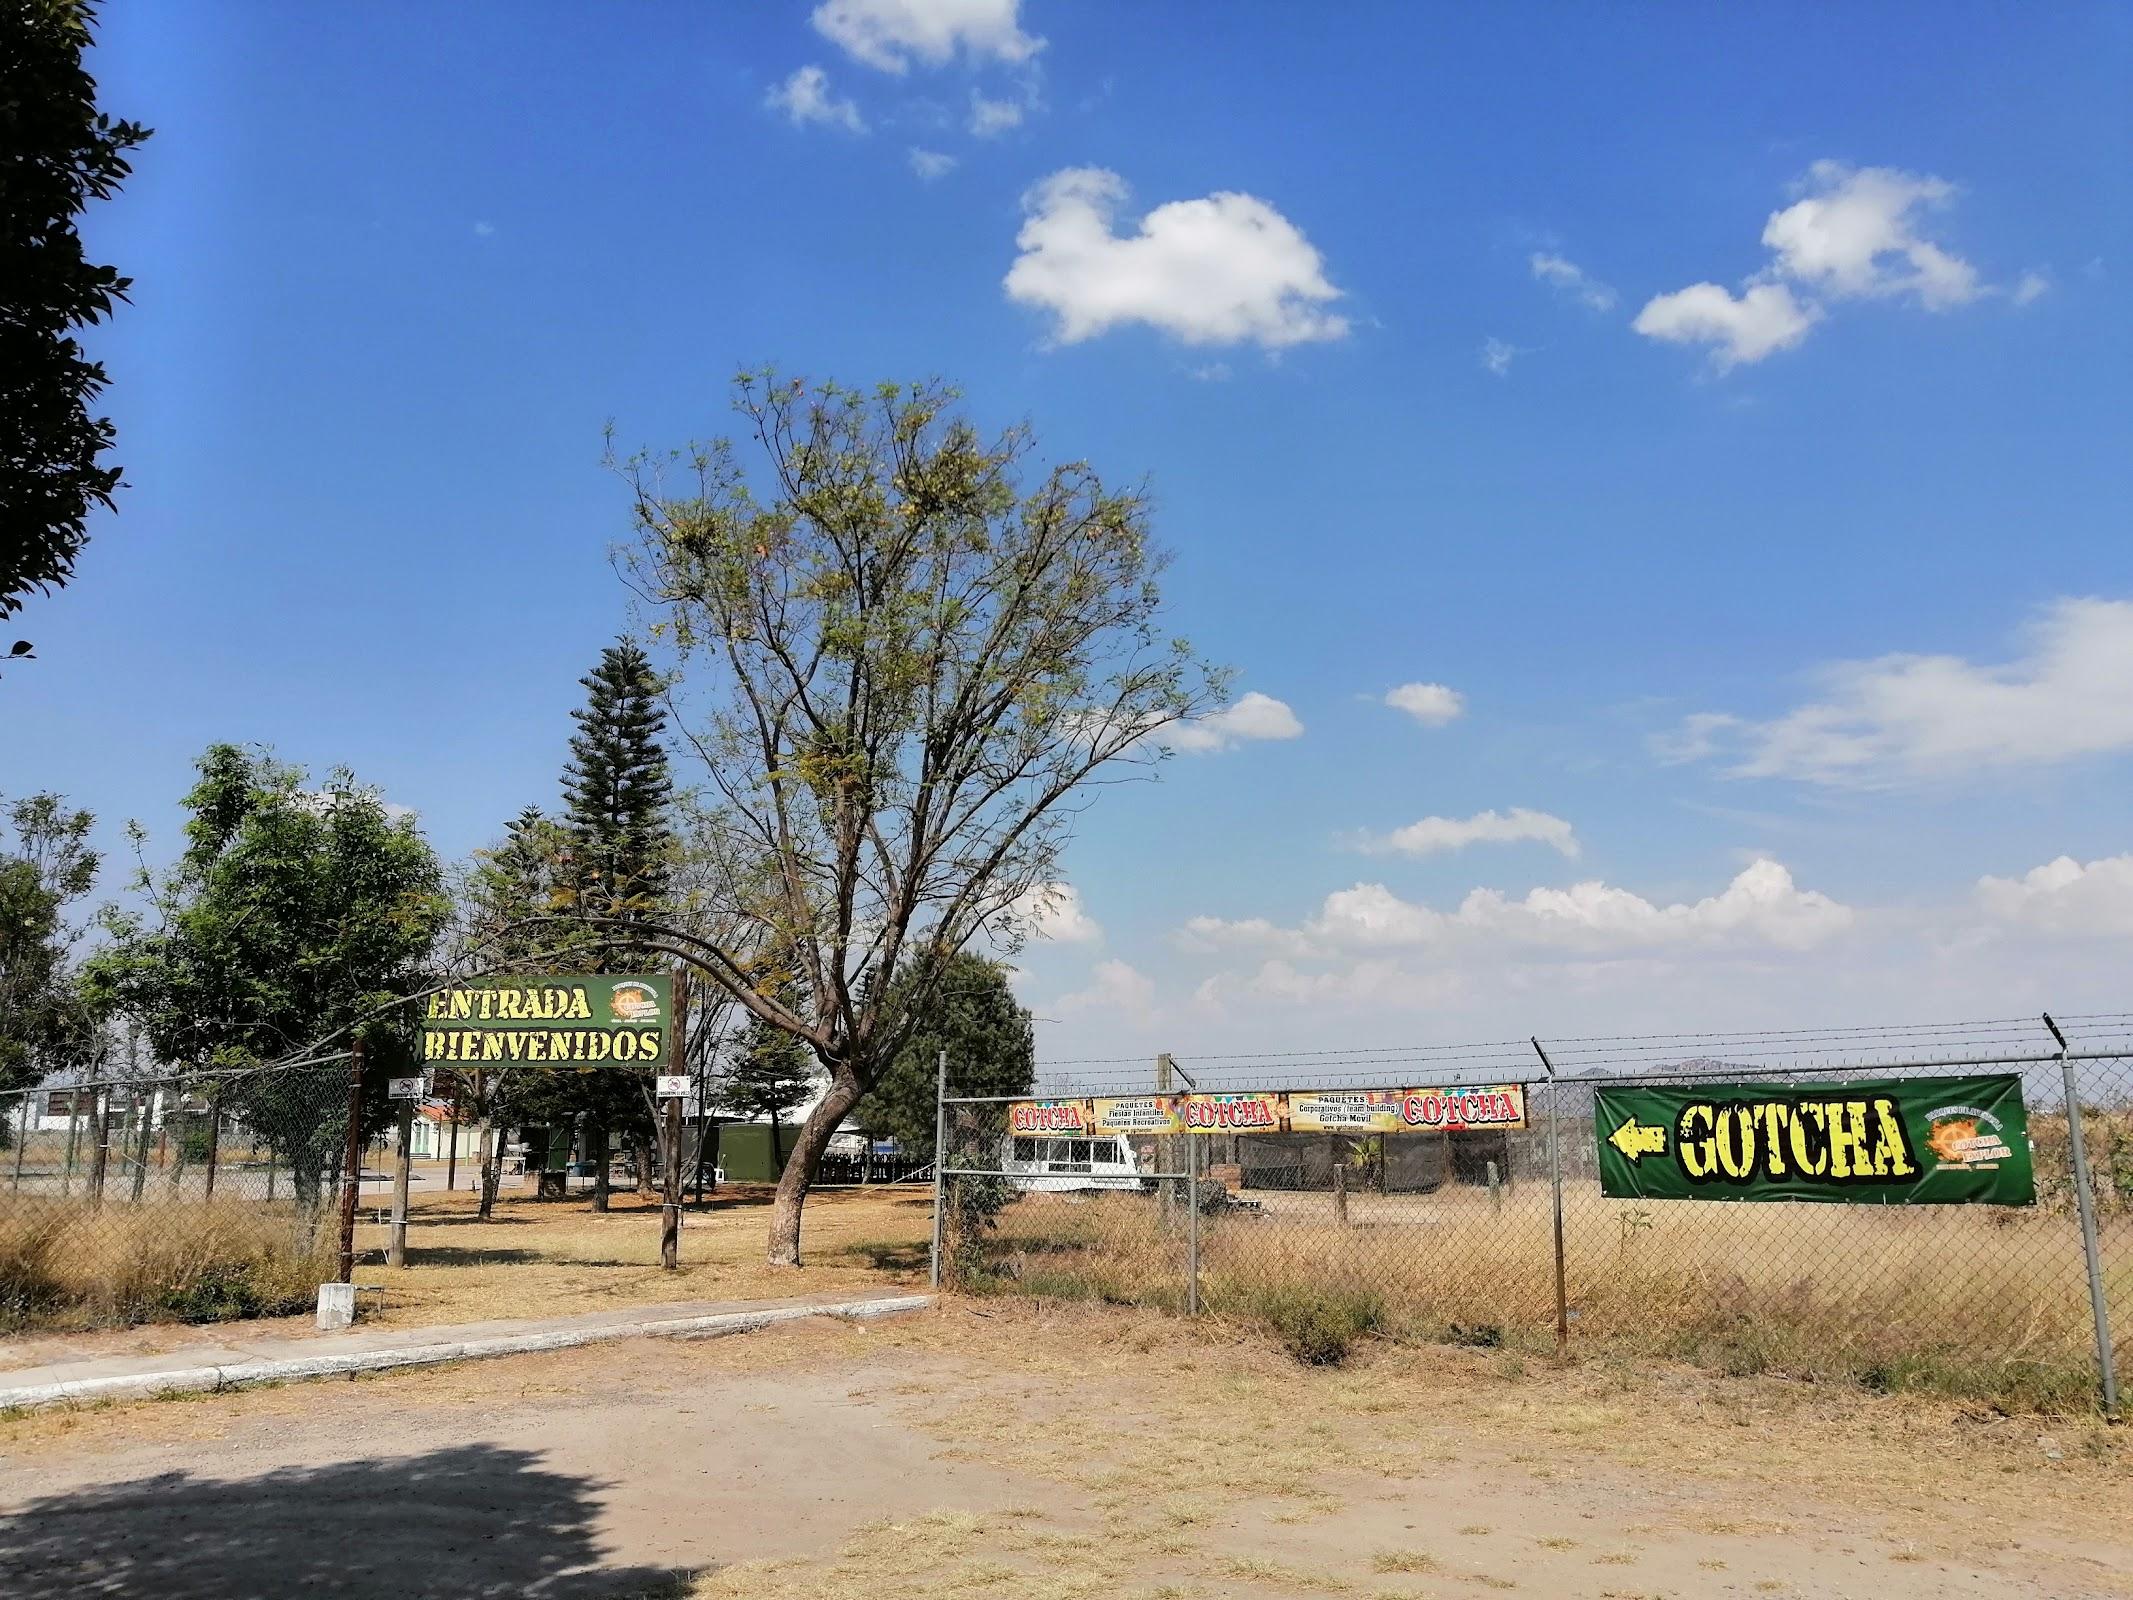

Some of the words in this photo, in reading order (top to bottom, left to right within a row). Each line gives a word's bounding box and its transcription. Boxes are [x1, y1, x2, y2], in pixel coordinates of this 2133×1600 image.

[427, 987, 591, 1020] ENTRADA
[424, 1030, 660, 1061] BIENVENIDOS
[1013, 1105, 1082, 1130] GOTCHA
[1102, 1119, 1131, 1127] Paquetes
[1132, 1118, 1171, 1126] Recreativos
[1109, 1110, 1132, 1118] Fiestas
[1133, 1108, 1164, 1117] Infantiles
[1185, 1099, 1274, 1128] GOTCHA
[1299, 1105, 1341, 1114] Corporativos
[1319, 1114, 1347, 1122] Gotcha
[1403, 1093, 1520, 1125] GOTCHA
[1679, 1099, 1915, 1178] GOTCHA
